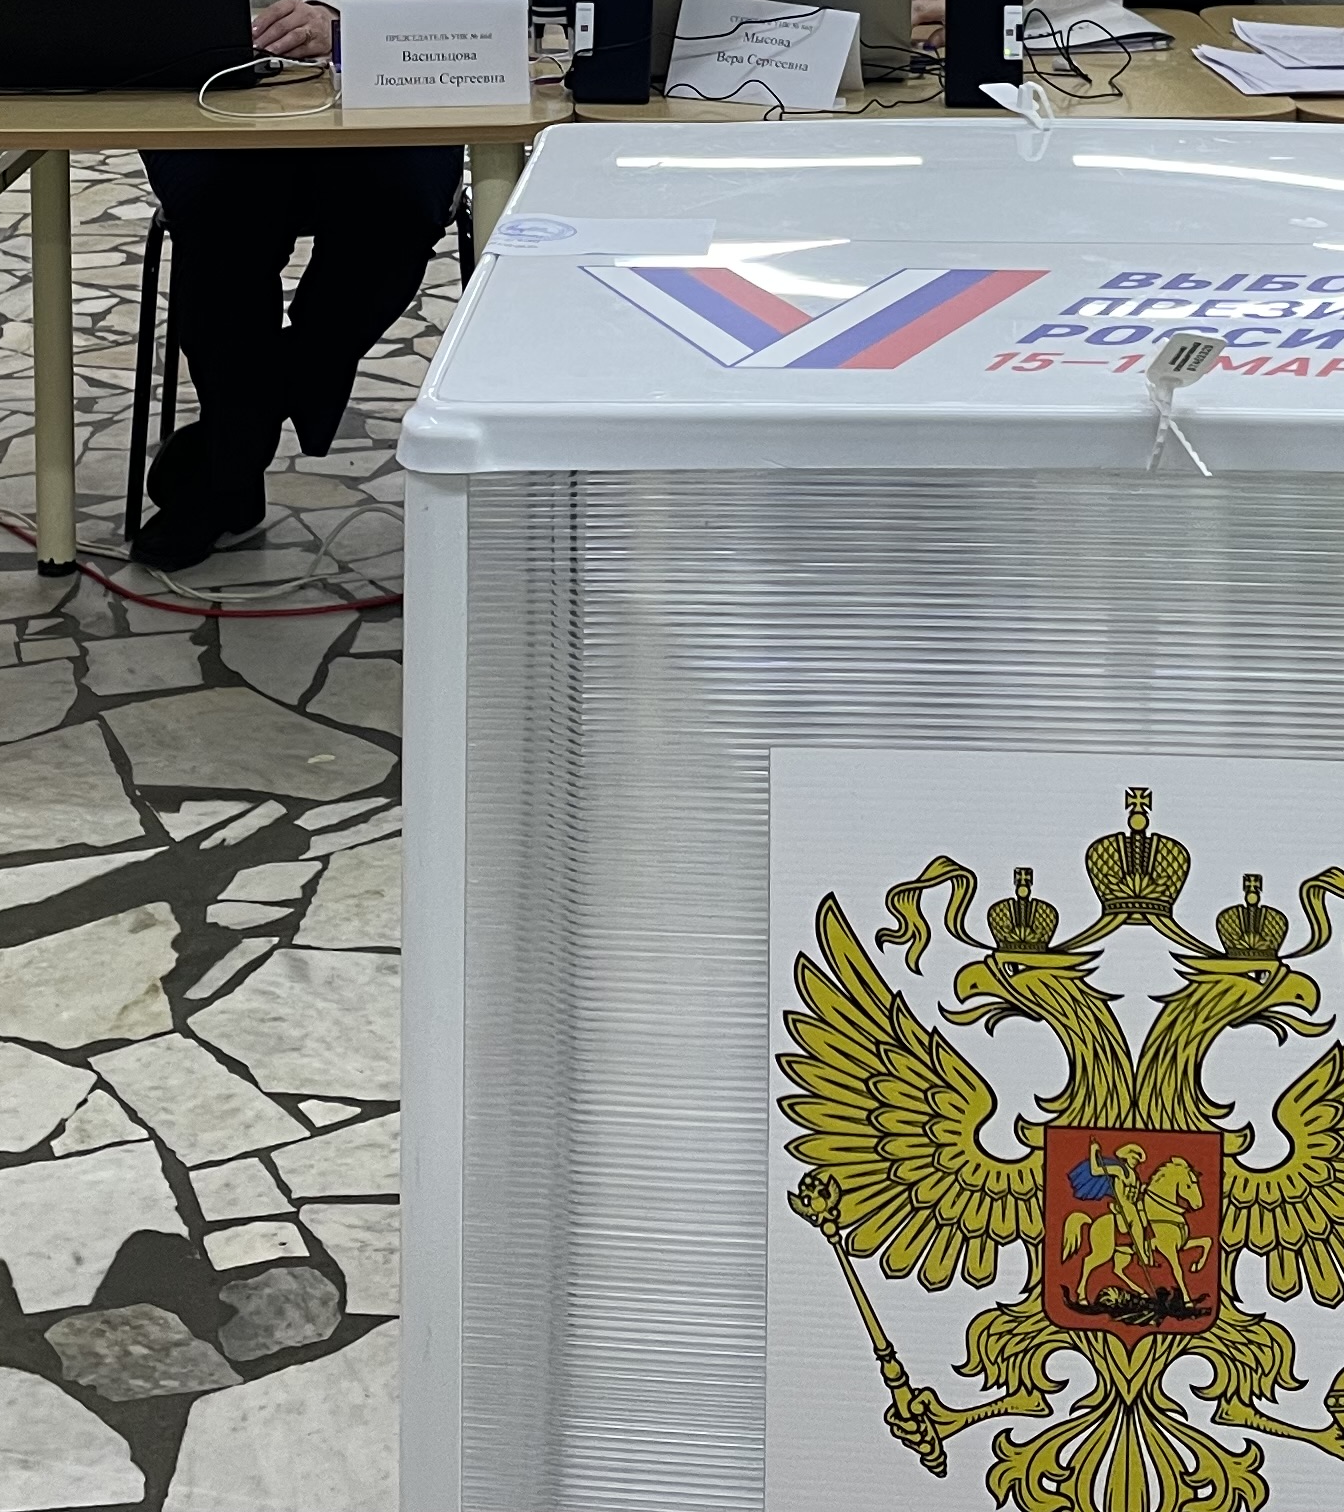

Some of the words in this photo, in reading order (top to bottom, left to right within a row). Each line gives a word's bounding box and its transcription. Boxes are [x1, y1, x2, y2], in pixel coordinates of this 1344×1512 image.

[743, 32, 791, 48] Мысова
[402, 50, 477, 62] Васильцова
[716, 51, 744, 65] Вера
[747, 54, 809, 72] Сергеевна
[374, 74, 436, 86] Людмила
[439, 72, 505, 87] Сергеевна
